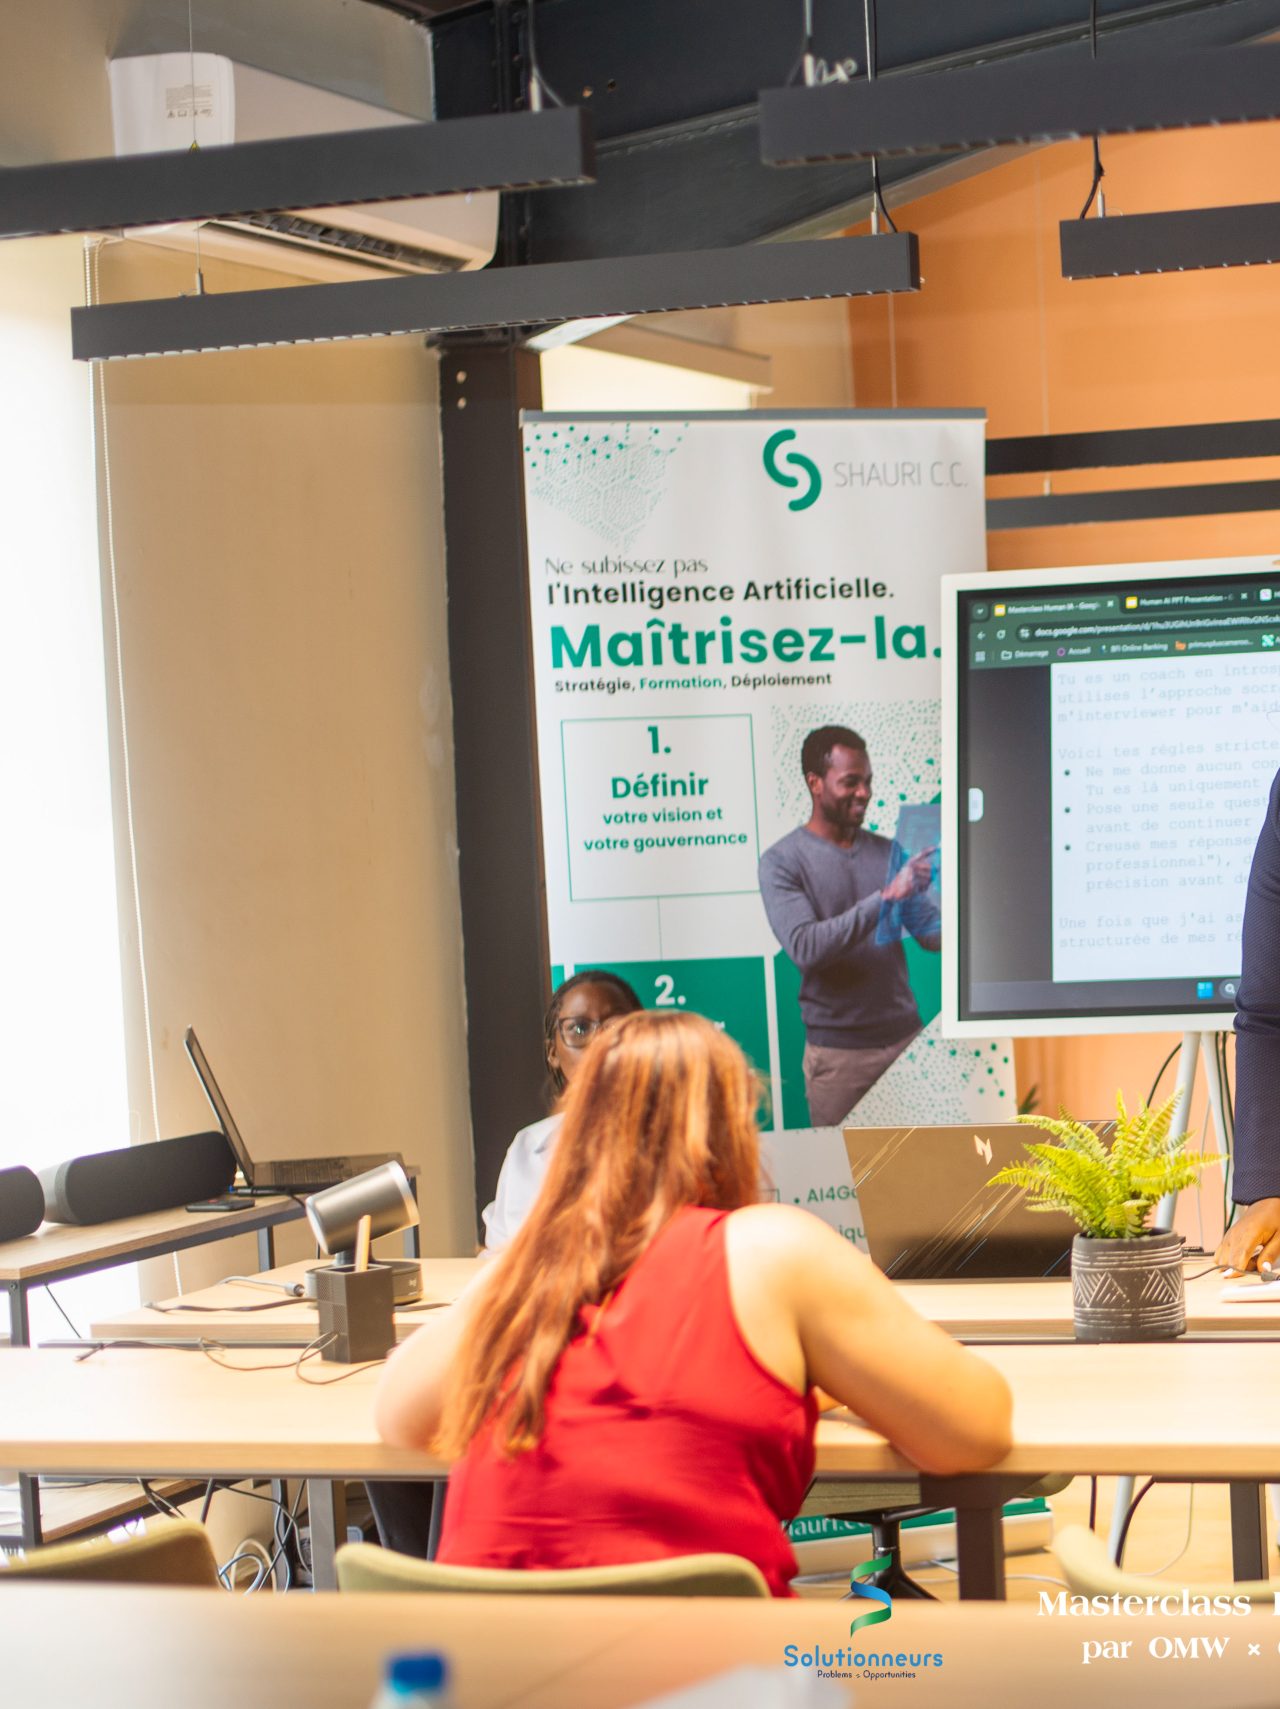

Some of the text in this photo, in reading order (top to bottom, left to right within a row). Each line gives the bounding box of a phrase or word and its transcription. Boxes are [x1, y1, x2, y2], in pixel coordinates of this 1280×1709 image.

[834, 461, 968, 488] SHAURI C.C.
[545, 555, 708, 578] Ne subissez pas
[548, 577, 895, 610] l'Intelligence Artificielle.
[550, 615, 941, 668] Maîtrisez-la.
[555, 673, 832, 696] Stratégie, Formation, Déploiement
[1058, 673, 1076, 685] Tu
[1085, 674, 1104, 684] es
[1113, 672, 1130, 683] un
[1140, 668, 1185, 680] coach
[1195, 668, 1213, 678] en
[1058, 688, 1130, 703] utilises
[1186, 705, 1223, 718] pour
[647, 725, 672, 754] 1.
[1058, 747, 1103, 760] Voici
[1114, 746, 1141, 758] tes
[1151, 741, 1204, 757] règles
[1086, 766, 1104, 778] Ne
[1113, 767, 1130, 777] me
[1140, 763, 1187, 775] donne
[1196, 761, 1243, 773] aucun
[611, 771, 709, 799] Définir
[1087, 784, 1104, 797] Tu
[1113, 785, 1130, 795] es
[1168, 778, 1259, 795] uniquement
[603, 807, 723, 825] votre vision et
[1087, 803, 1122, 815] Pose
[1133, 802, 1158, 813] une
[1168, 799, 1214, 812] seule
[1086, 817, 1251, 833] avant de continuer
[584, 833, 748, 853] votre gouvernance
[1086, 840, 1141, 853] Creuse
[1151, 839, 1178, 850] mes
[1086, 876, 1169, 893] précision
[1179, 873, 1224, 886] avant
[1058, 917, 1087, 929] Une
[1097, 914, 1132, 928] fois
[1142, 914, 1168, 929] que
[1058, 934, 1151, 949] structurée
[1161, 933, 1179, 945] de
[1188, 933, 1216, 944] mes
[654, 974, 687, 1006] 2.
